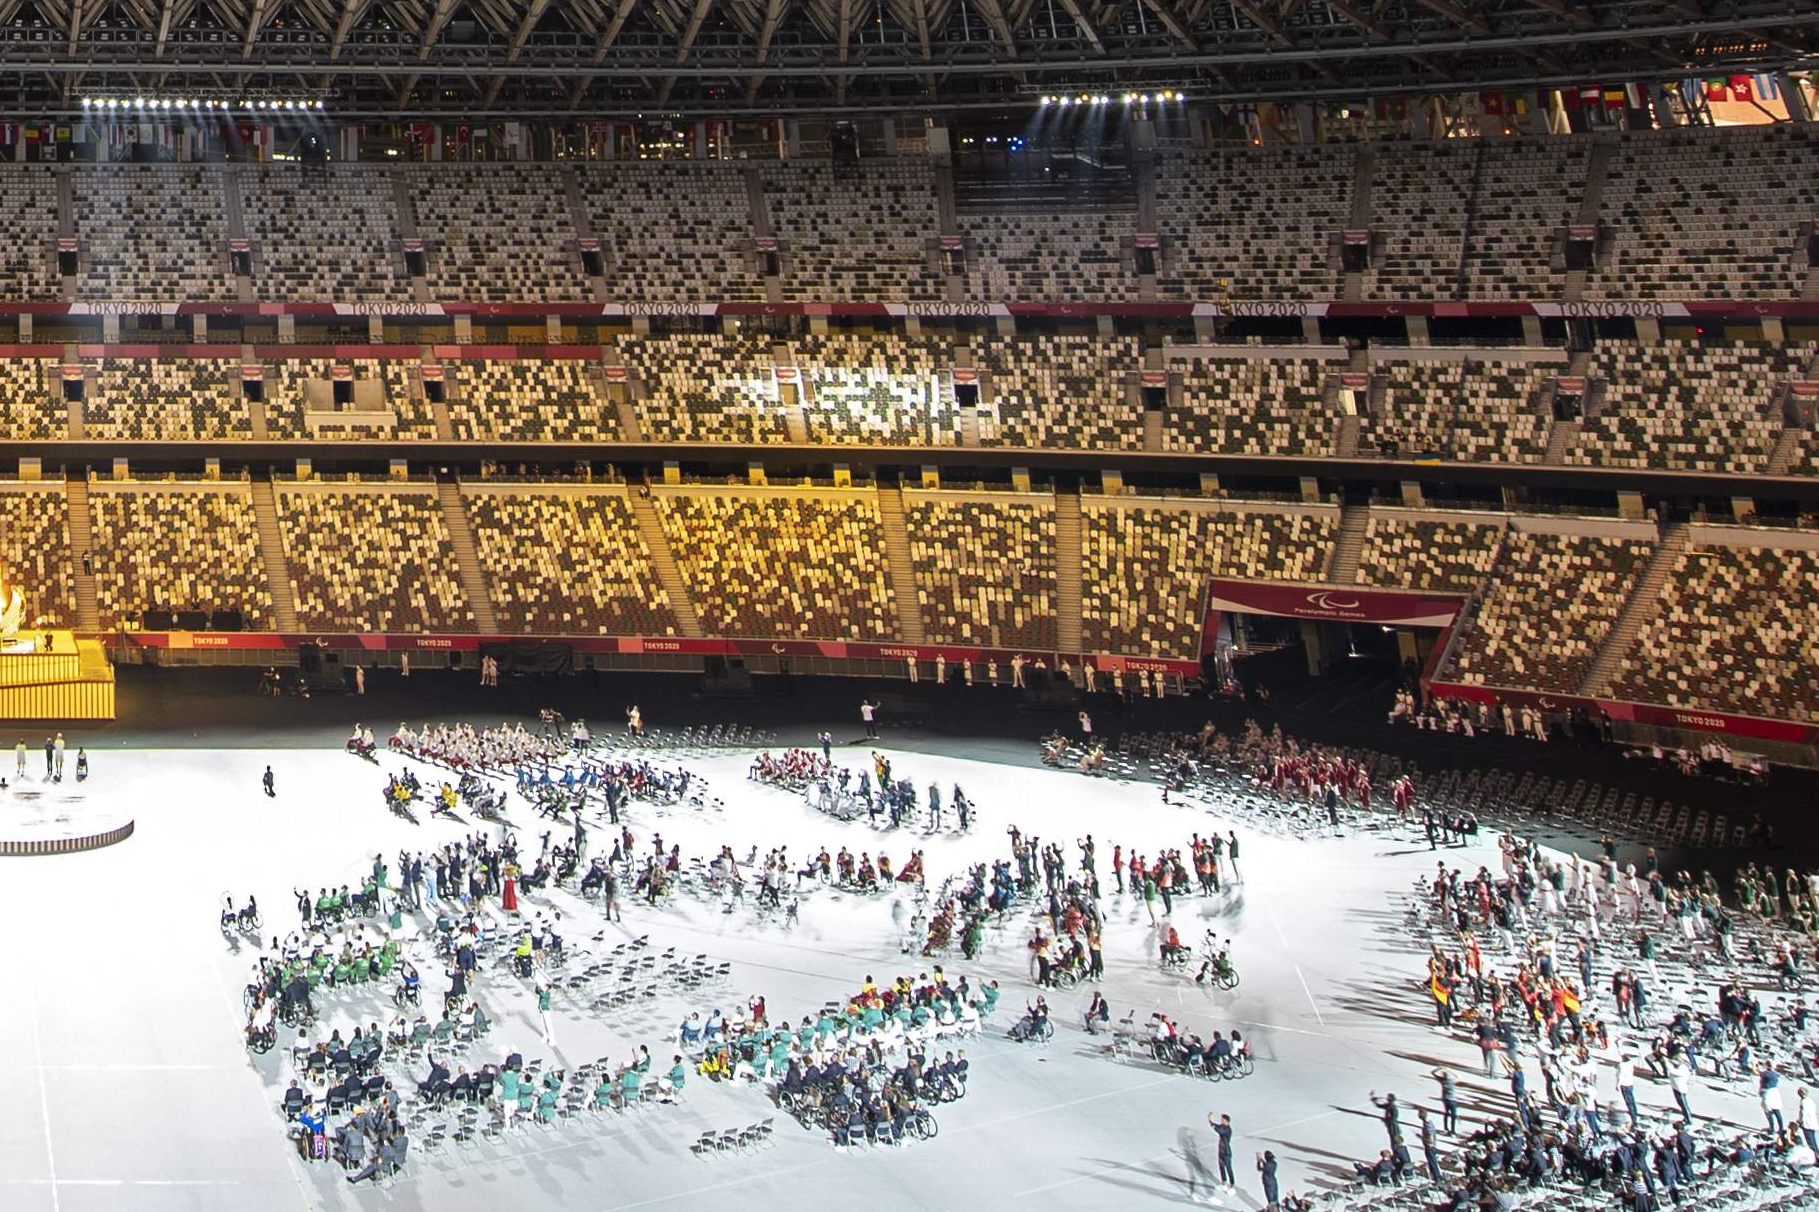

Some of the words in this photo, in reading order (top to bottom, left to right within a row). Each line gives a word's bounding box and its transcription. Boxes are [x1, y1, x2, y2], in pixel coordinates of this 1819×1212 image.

[87, 303, 128, 314] TOKYO
[131, 303, 162, 314] 2020
[352, 303, 392, 314] TOKYO
[396, 303, 427, 314] 2020
[622, 303, 664, 315] TOKYO
[668, 303, 700, 315] 2020
[905, 303, 951, 316] TOKYO
[955, 303, 991, 316] 2020
[1214, 302, 1264, 316] TKYO
[1268, 302, 1307, 316] 2020
[1557, 302, 1616, 317] TOKYO
[1619, 302, 1664, 317] 2020
[1338, 610, 1365, 618] Games
[194, 637, 213, 645] TOKYO
[417, 639, 436, 647] TOKYO
[644, 642, 664, 650] TOKYO
[880, 648, 901, 656] TOKYO
[1676, 714, 1703, 725] TOKYO
